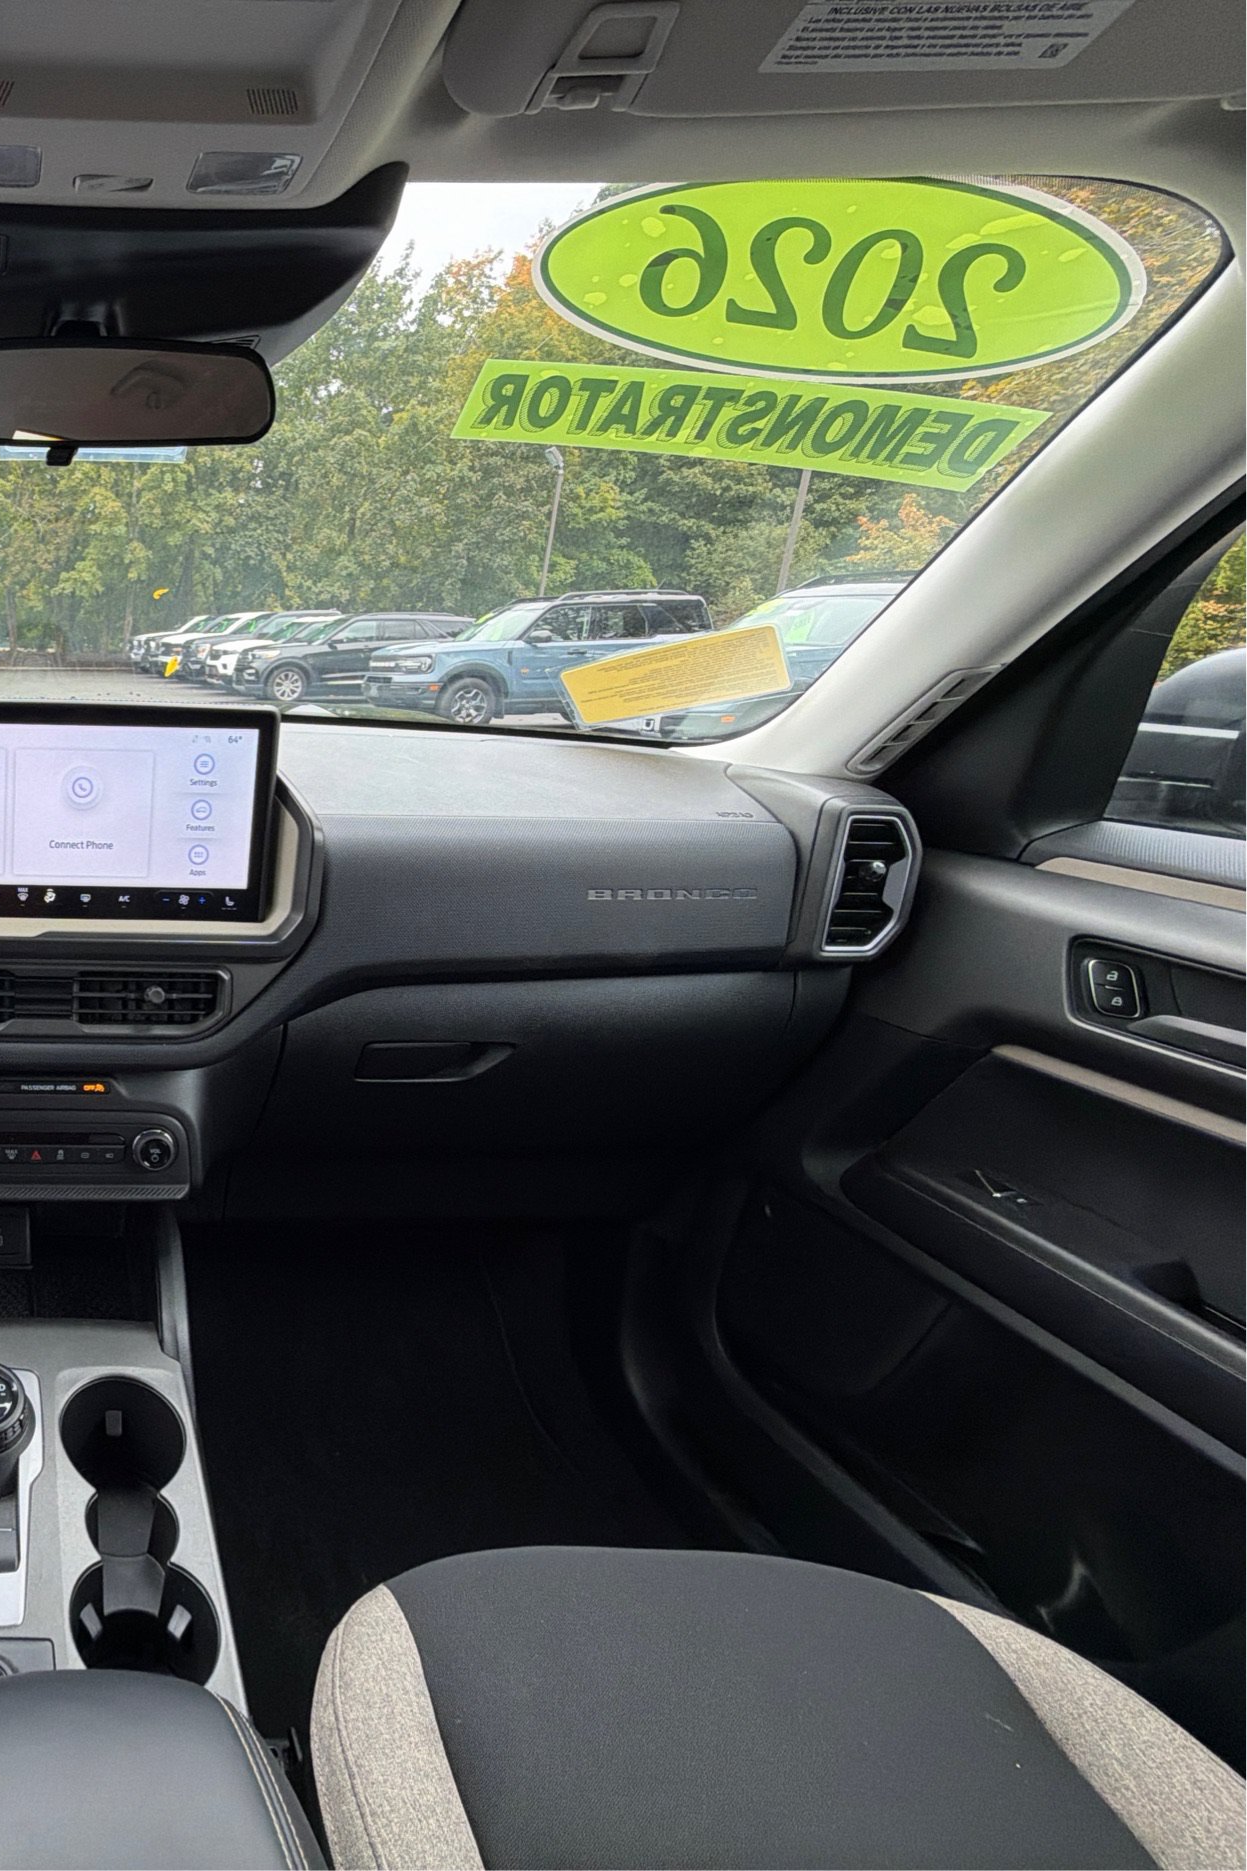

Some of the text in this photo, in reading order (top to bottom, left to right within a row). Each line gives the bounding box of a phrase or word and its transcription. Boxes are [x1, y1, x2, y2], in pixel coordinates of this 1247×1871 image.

[189, 778, 218, 787] Settings
[186, 824, 215, 832] Features
[49, 840, 114, 850] Connect Phone
[189, 868, 206, 877] Apps
[587, 888, 758, 900] BRONCO
